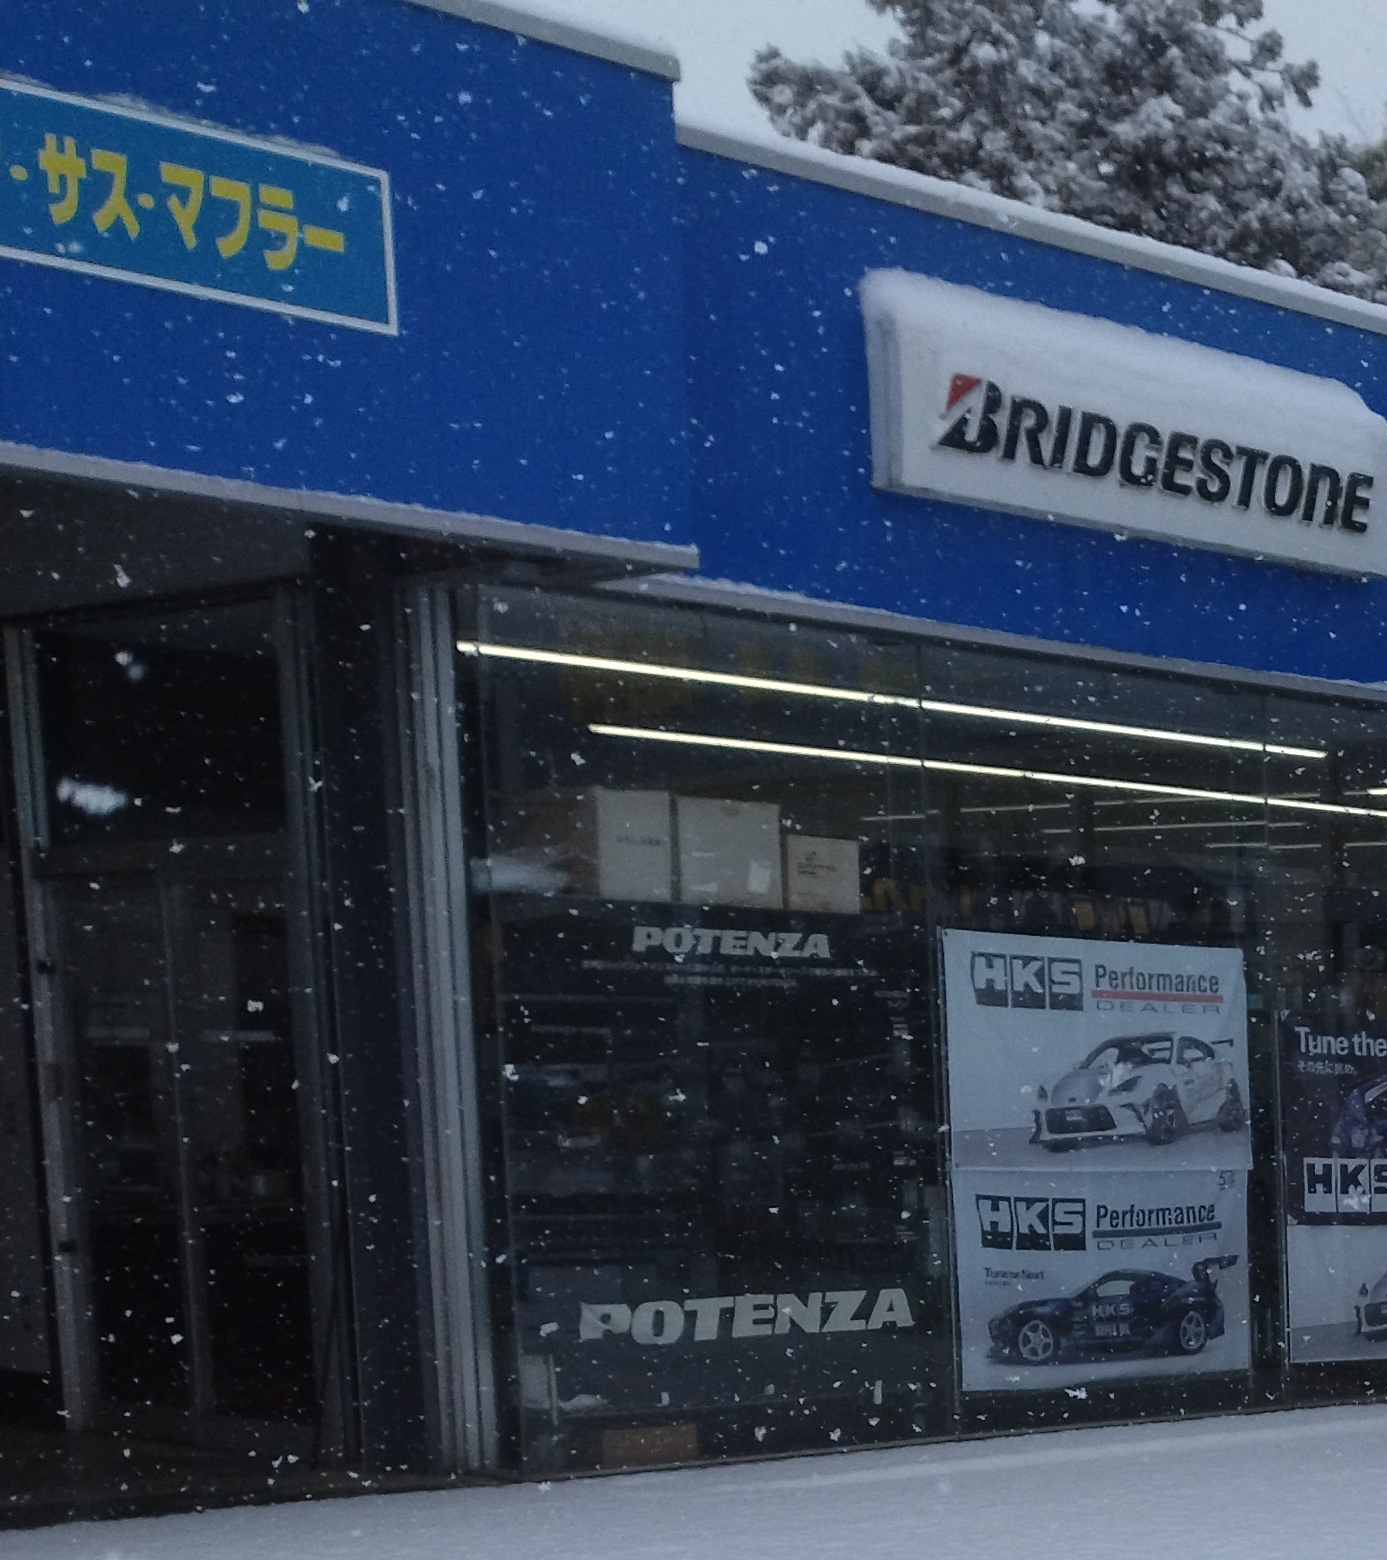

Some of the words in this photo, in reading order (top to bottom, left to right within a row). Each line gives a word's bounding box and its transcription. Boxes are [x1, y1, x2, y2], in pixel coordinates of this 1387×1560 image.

[934, 374, 1375, 534] BRIDGESTONE
[632, 925, 831, 960] POTENZA
[972, 952, 1083, 1004] HKS
[1094, 963, 1220, 996] Performance
[1096, 1000, 1220, 1015] DEALER
[1294, 1026, 1349, 1057] Tune
[1353, 1030, 1387, 1058] the
[976, 1195, 1086, 1246] HKS
[1096, 1203, 1216, 1229] Performance
[1097, 1232, 1217, 1251] DEALER
[579, 1287, 916, 1346] POTENZA
